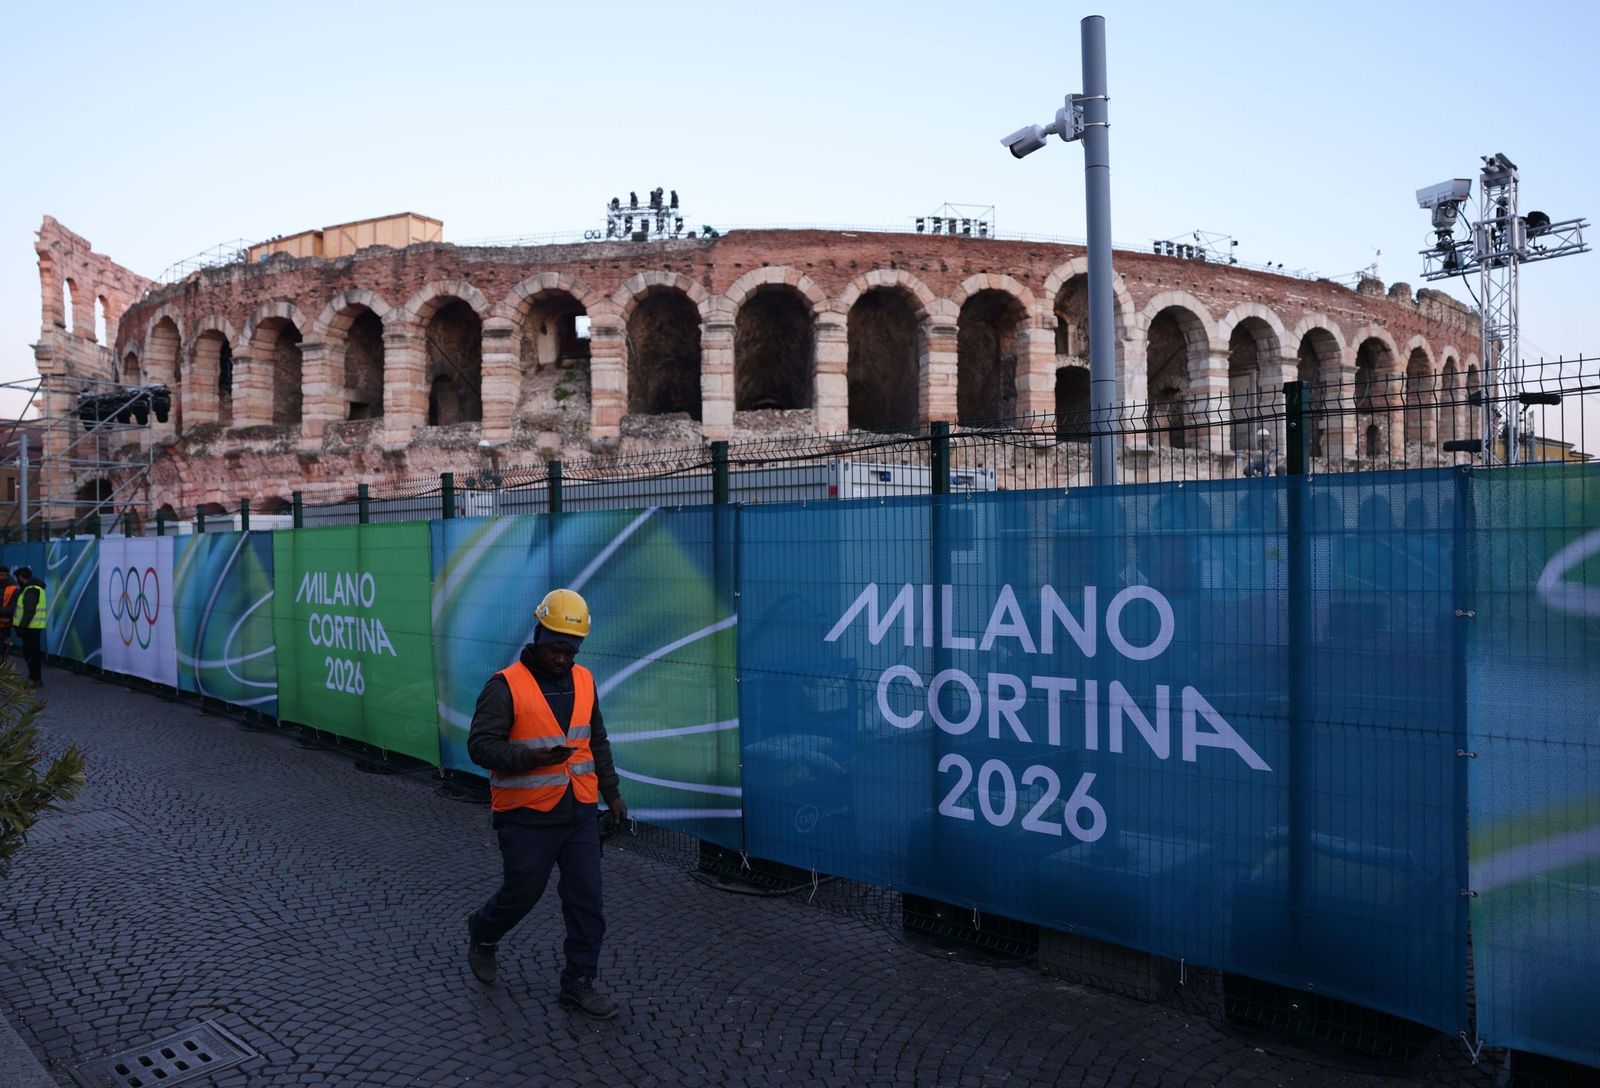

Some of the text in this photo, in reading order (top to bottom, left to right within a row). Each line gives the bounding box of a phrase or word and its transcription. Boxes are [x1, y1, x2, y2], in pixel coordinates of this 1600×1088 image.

[295, 571, 376, 608] MILANO
[308, 612, 398, 657] CORTINA
[823, 582, 1175, 661] MILANO
[325, 656, 366, 696] 2026
[876, 664, 1273, 772] CORTINA
[937, 753, 1107, 842] 2026
